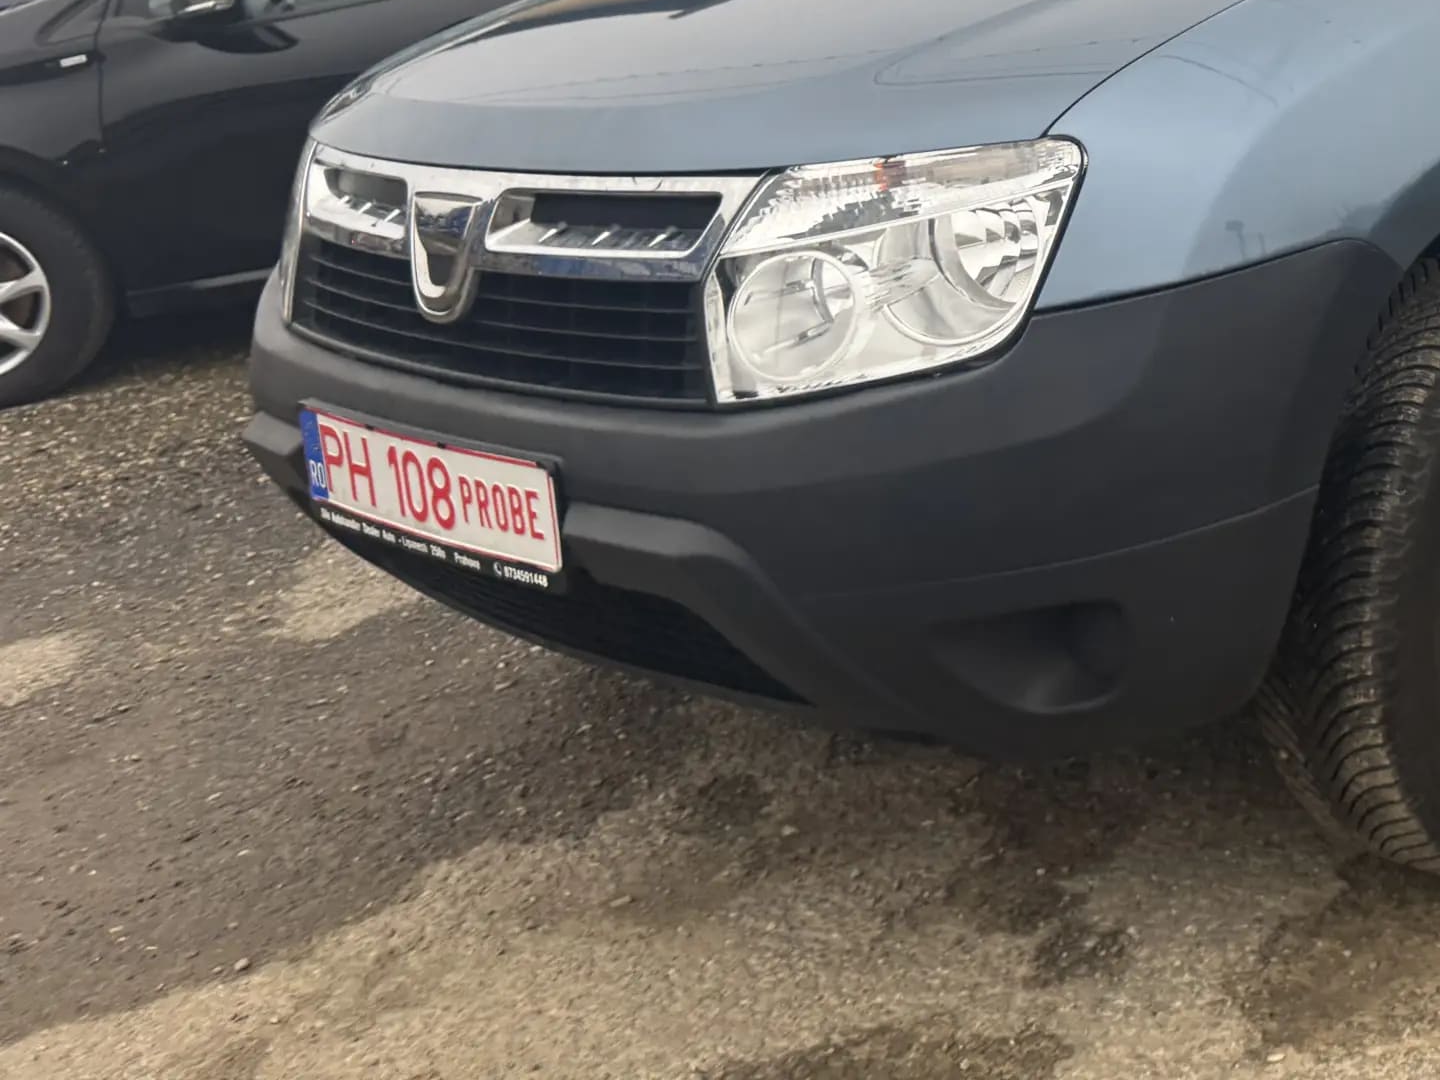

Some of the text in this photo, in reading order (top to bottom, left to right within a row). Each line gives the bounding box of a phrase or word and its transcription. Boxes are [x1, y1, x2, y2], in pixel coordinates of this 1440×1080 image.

[309, 460, 327, 488] RO
[318, 424, 545, 541] PH 108 PROBE
